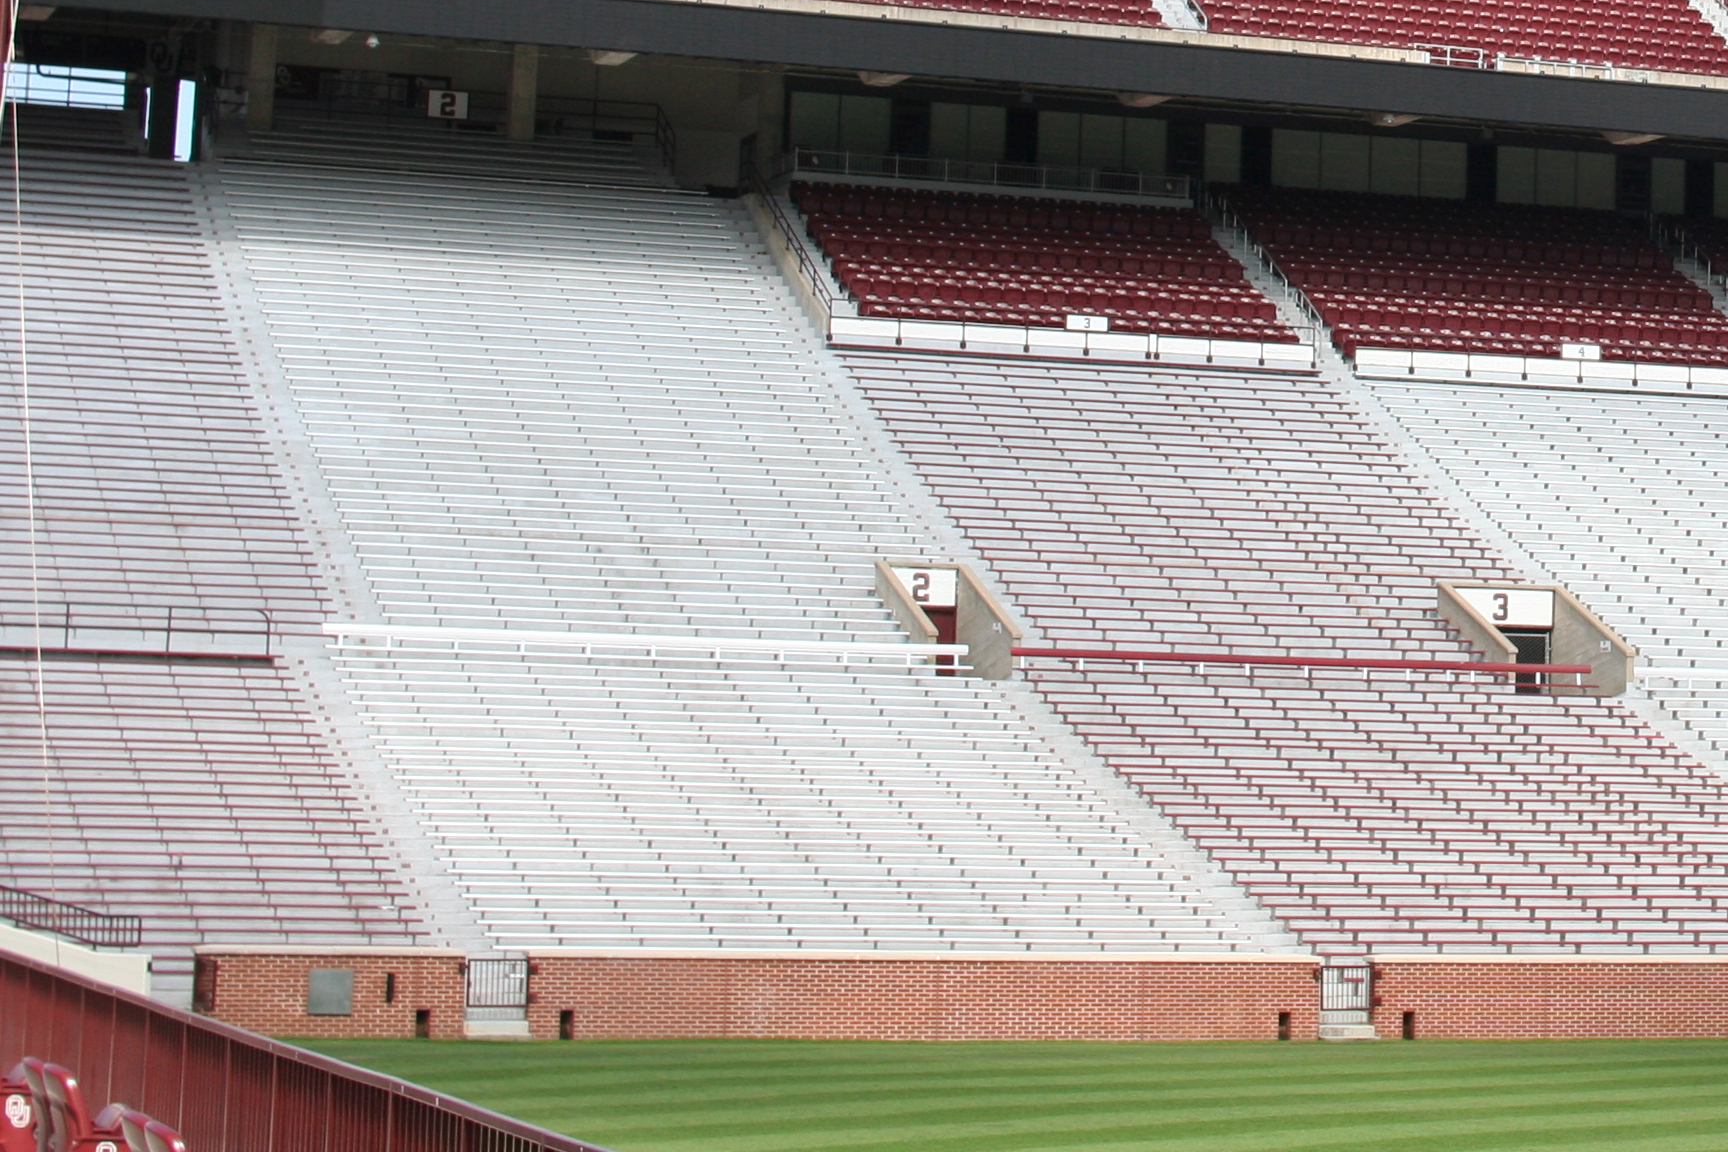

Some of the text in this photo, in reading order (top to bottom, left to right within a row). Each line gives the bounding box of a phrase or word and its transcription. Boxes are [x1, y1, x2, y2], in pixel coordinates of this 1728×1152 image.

[440, 92, 456, 117] 2
[912, 572, 930, 602] 2
[1492, 593, 1508, 621] 3
